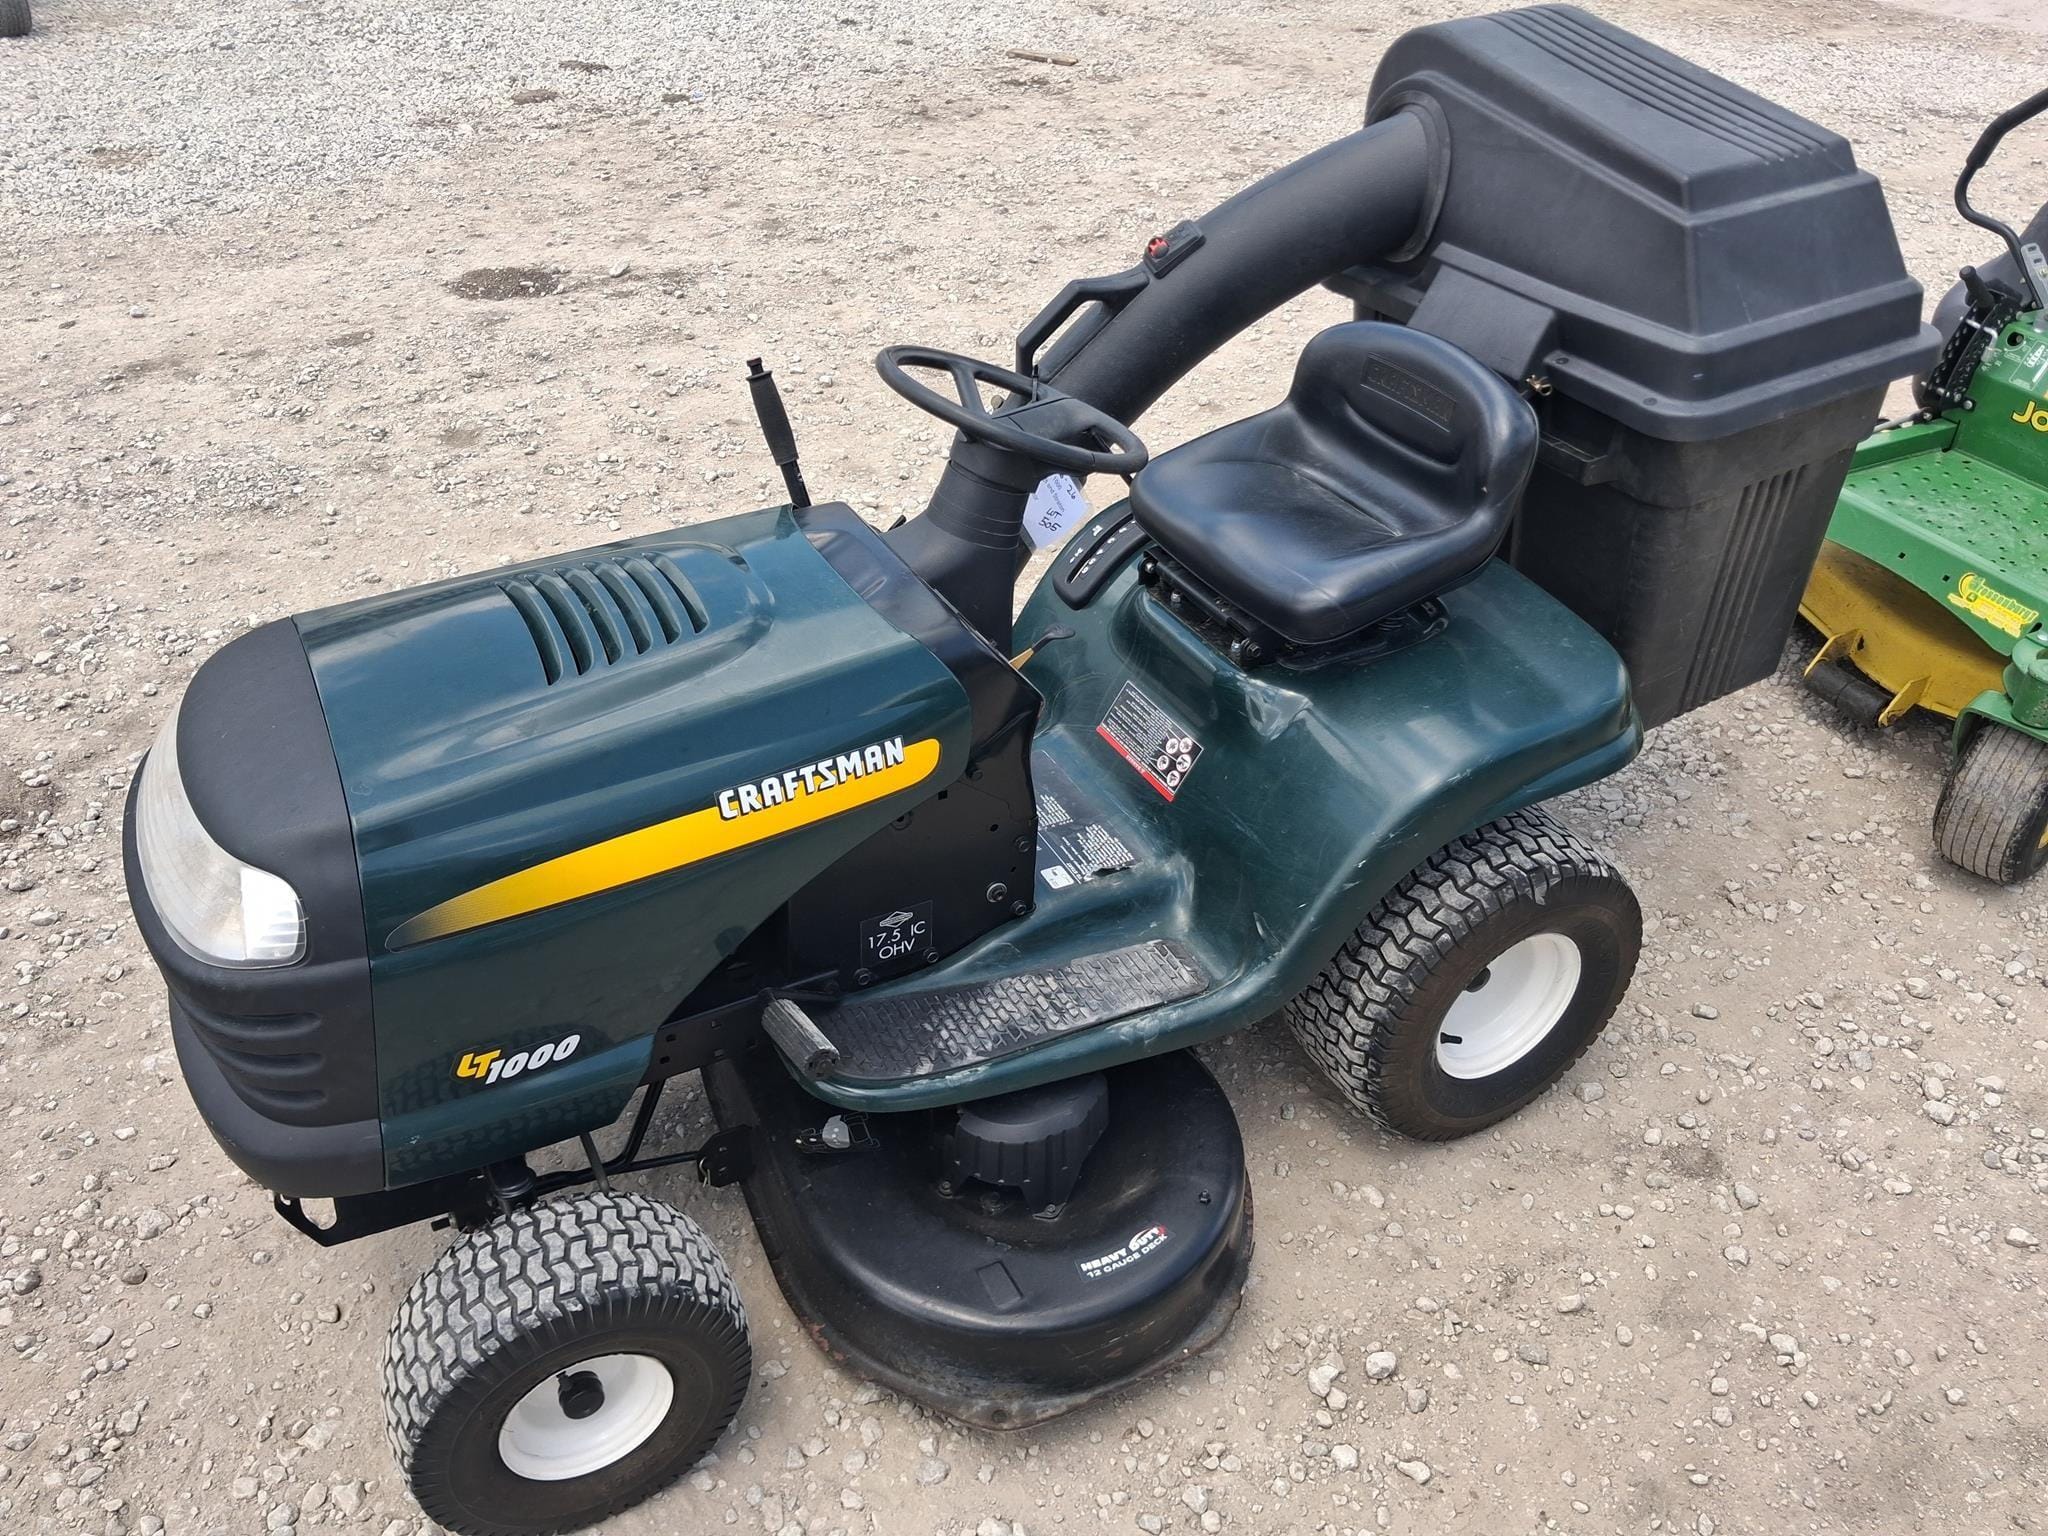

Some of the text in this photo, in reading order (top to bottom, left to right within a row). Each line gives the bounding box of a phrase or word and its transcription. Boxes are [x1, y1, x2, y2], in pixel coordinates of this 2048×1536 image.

[1039, 516, 1062, 532] 505
[718, 737, 904, 820] CRAFTSMAN
[868, 920, 926, 949] 17.5 IC
[878, 938, 915, 959] OHV
[1080, 1248, 1127, 1272] HEAVY
[1086, 1233, 1168, 1278] 12 GAUGE DECK
